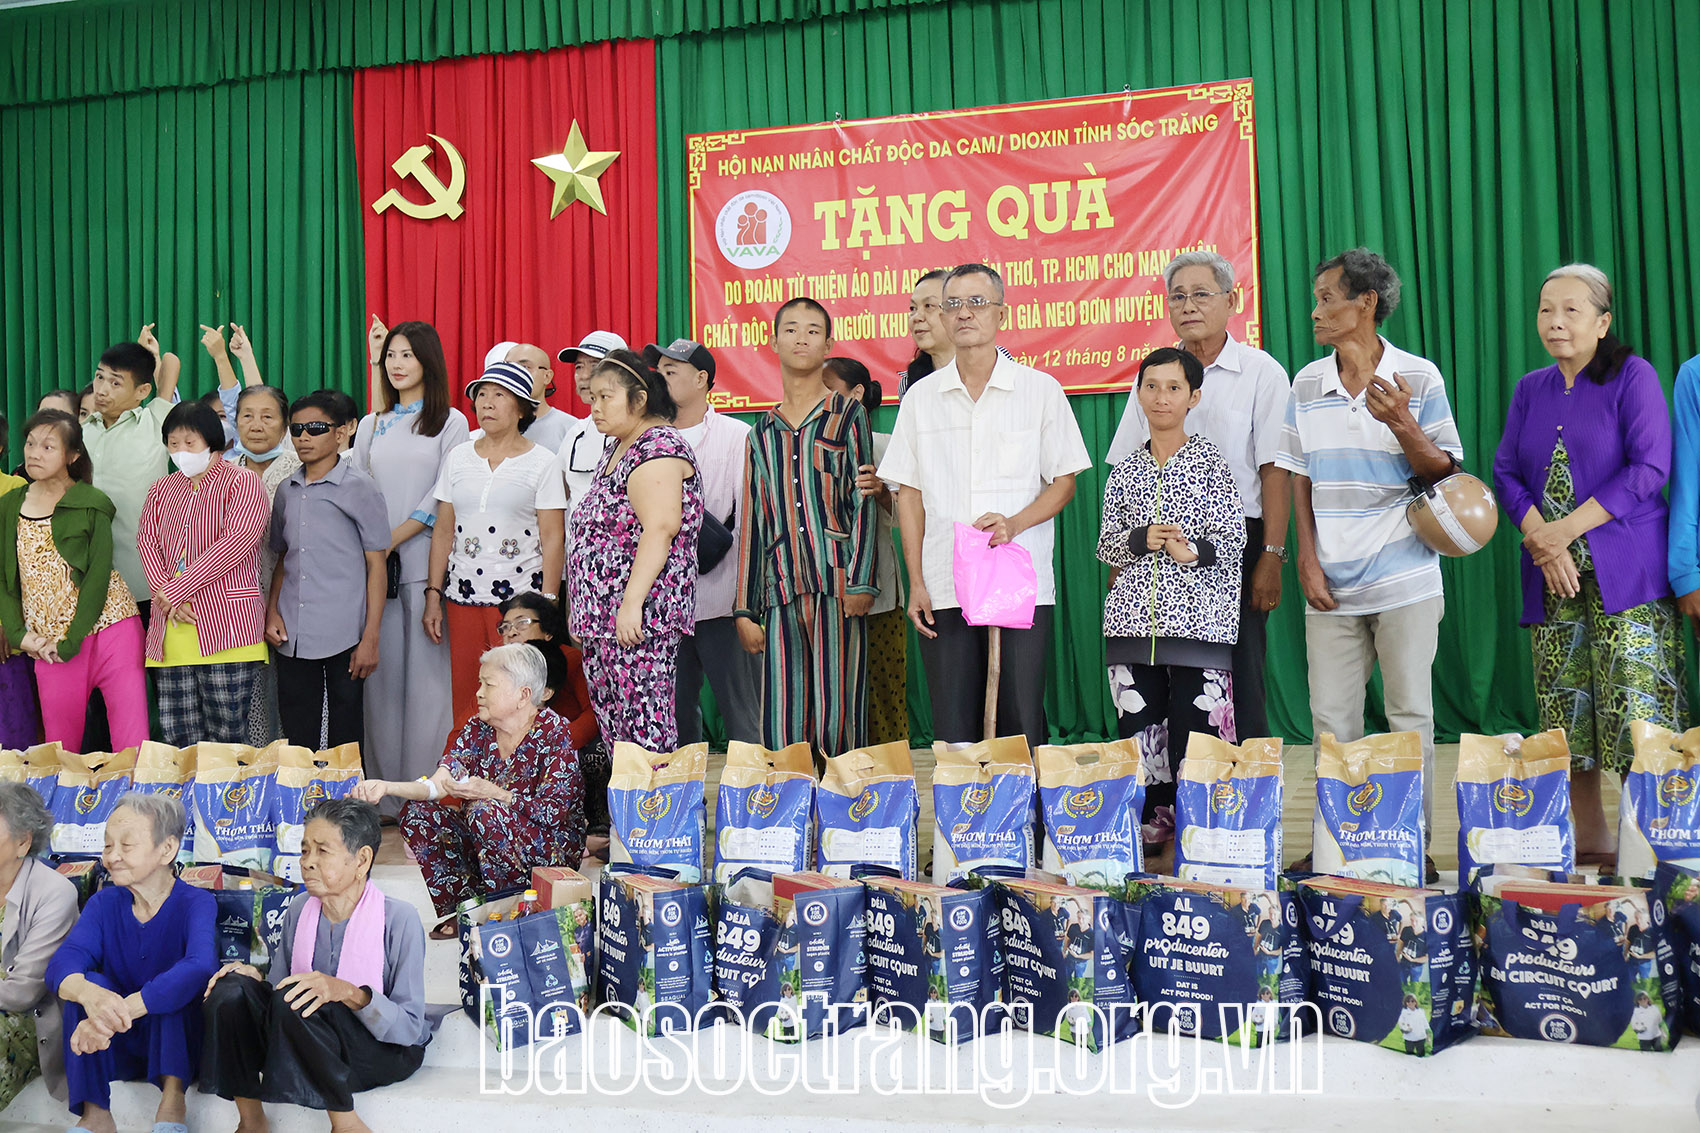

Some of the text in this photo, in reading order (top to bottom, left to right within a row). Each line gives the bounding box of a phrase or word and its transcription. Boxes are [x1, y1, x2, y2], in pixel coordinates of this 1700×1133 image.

[718, 112, 1219, 180] HỘI NẠN NHÂN CHẤT ĐỘC DA CAM/ DIOXIN TỈNH SÓC TRĂNG
[814, 185, 972, 260] TẶNG
[986, 162, 1115, 240] QUÀ
[726, 245, 780, 258] VAVA
[1005, 256, 1038, 288] THƠ,
[1042, 258, 1061, 284] TP.
[1065, 254, 1100, 281] HCM
[1104, 251, 1134, 279] CHO
[1138, 249, 1171, 282] NẠN
[724, 280, 742, 306] DO
[744, 274, 783, 304] ĐOÀN
[787, 272, 805, 299] TỪ
[808, 269, 848, 304] THIỆN
[851, 266, 870, 298] ÁO
[873, 265, 898, 296] DÀI
[1016, 298, 1041, 330] GIÀ
[1046, 300, 1076, 328] NEO
[1080, 296, 1111, 325] ĐƠN
[1115, 290, 1165, 326] HUYỆN
[703, 315, 738, 348] CHẤT
[742, 316, 769, 351] ĐỘC
[833, 309, 876, 341] NGƯỜI
[1042, 350, 1060, 366] 12
[1065, 348, 1112, 368] tháng
[1116, 345, 1126, 362] 8
[628, 834, 692, 848] THƠM THÁI
[1339, 830, 1375, 842] THƠM
[1649, 827, 1691, 840] THƠM
[603, 898, 620, 927] 849
[1174, 897, 1193, 913] AL
[1322, 901, 1338, 917] AL
[726, 911, 750, 926] DÉJÀ
[866, 909, 895, 938] 849
[1002, 908, 1031, 938] 849
[1161, 912, 1210, 941] 849
[1530, 919, 1558, 933] DÉJÀ
[717, 920, 761, 952] 849
[1144, 937, 1229, 960] producenten
[890, 959, 918, 978] COURT
[1030, 960, 1056, 980] COURT
[1149, 956, 1224, 977] UIT JE BUURT
[1322, 962, 1334, 975] JE
[1335, 965, 1371, 983] BUURT
[1505, 952, 1596, 976] producteurs
[1176, 981, 1190, 989] DAT
[1329, 984, 1348, 995] DAT IS
[1491, 966, 1618, 999] EN CIRCUIT COURT
[1161, 988, 1213, 1001] ACT FOR FOOD!
[1318, 991, 1329, 999] ACT
[1329, 993, 1342, 1002] FOR
[1538, 993, 1561, 1001] C'EST
[1543, 1002, 1560, 1010] FOR
[1561, 1005, 1582, 1015] FOOD
